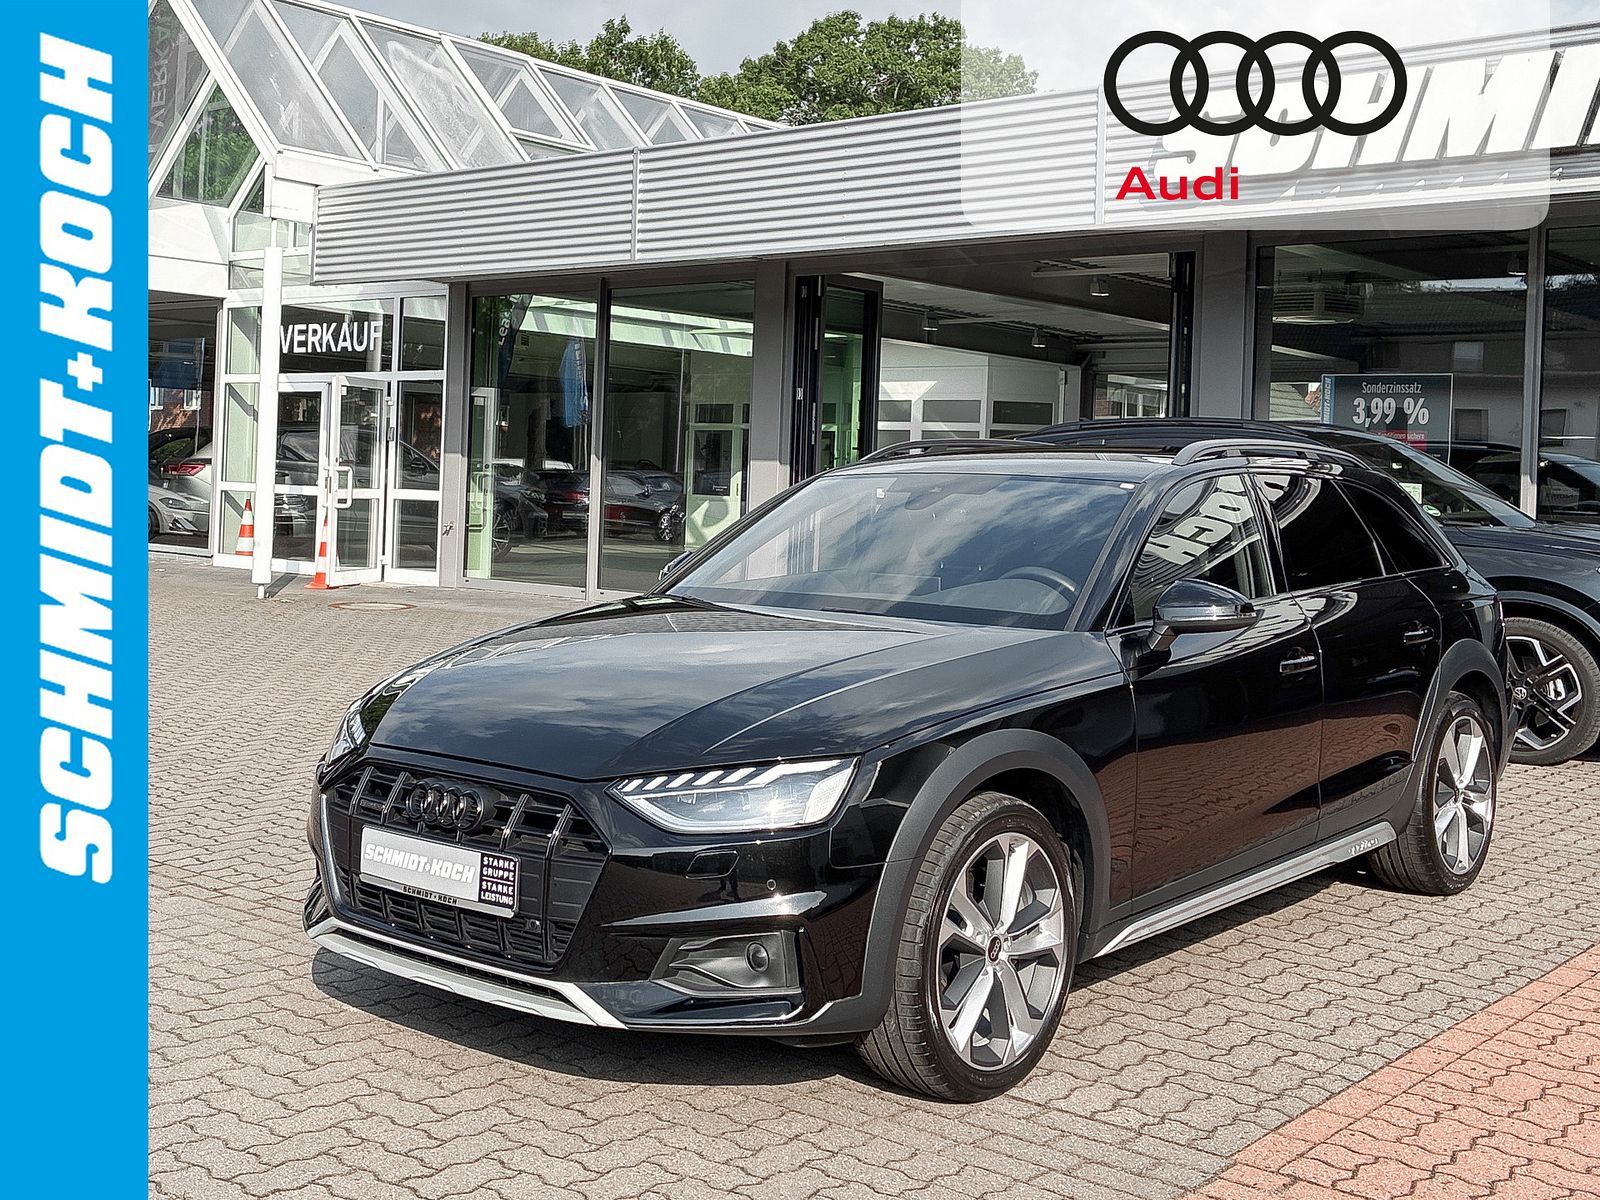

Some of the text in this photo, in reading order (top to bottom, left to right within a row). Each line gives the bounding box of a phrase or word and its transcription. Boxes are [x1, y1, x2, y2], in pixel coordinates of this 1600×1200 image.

[1153, 44, 1600, 185] SCHMI
[280, 320, 383, 354] VERKAUF
[1361, 381, 1423, 394] Sonderzinssatz
[1352, 396, 1430, 428] 3,99 %
[364, 843, 476, 884] SCHMIDT+KOCH
[482, 856, 515, 871] STARKE
[482, 867, 514, 882] GRUPPE
[481, 881, 514, 895] STARKE
[480, 891, 514, 906] LEISTUNG
